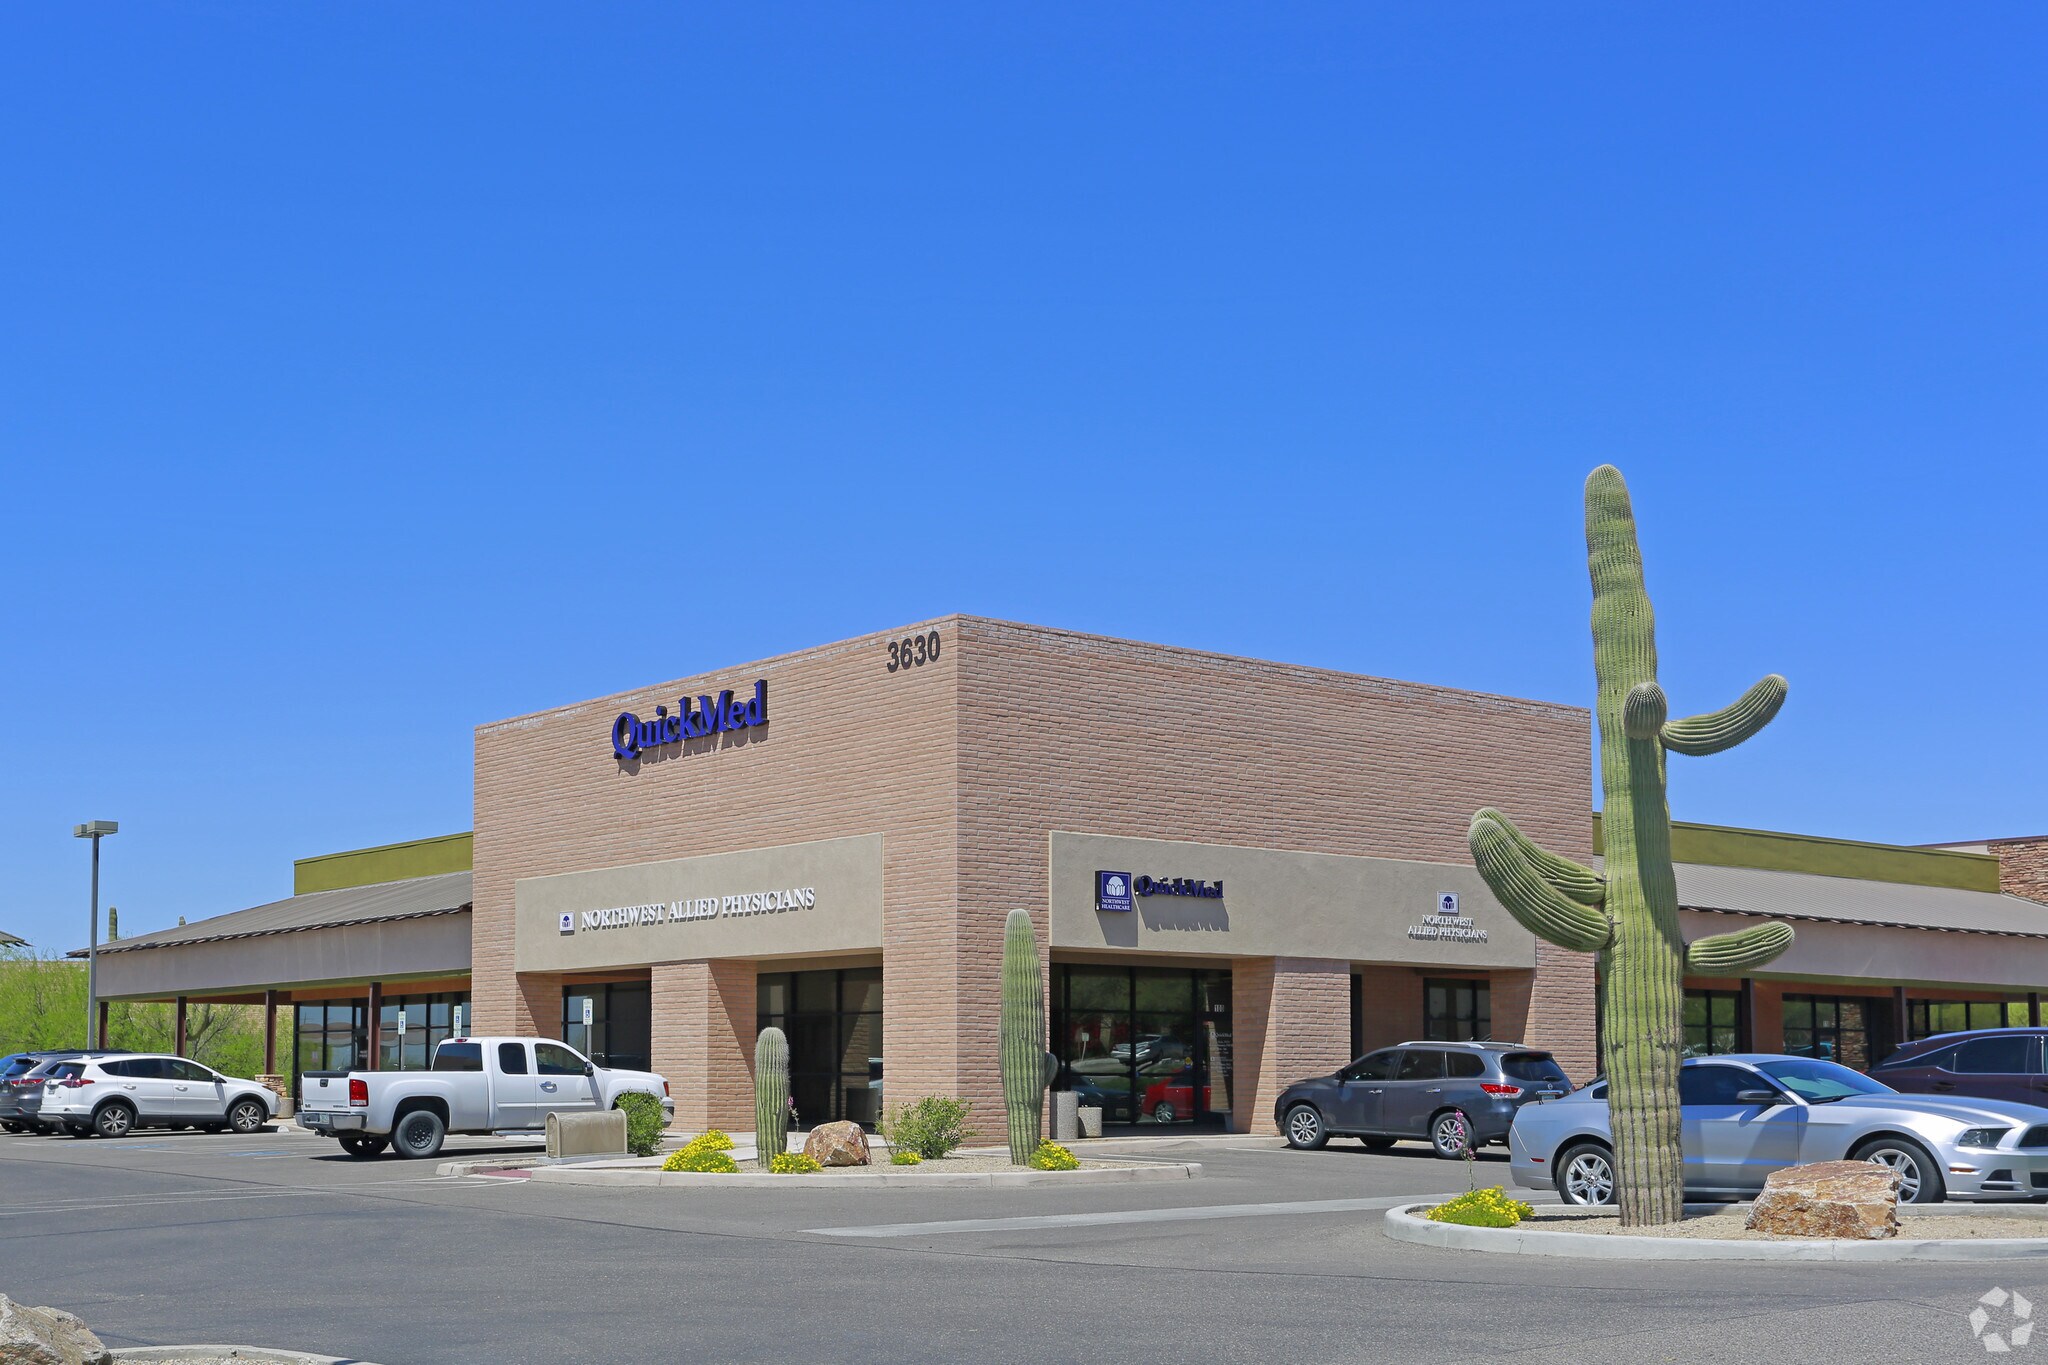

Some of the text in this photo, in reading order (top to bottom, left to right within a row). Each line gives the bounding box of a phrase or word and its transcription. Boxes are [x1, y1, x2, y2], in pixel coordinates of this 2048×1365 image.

[886, 631, 940, 673] 3630
[611, 679, 769, 760] QuickMed
[1133, 875, 1225, 899] QuickMed
[581, 887, 816, 930] NORTHWEST ALLIED PHYSICIANS
[1101, 903, 1131, 911] HEALTHCARE
[1408, 925, 1488, 939] ALLIED PHYSICIANS
[1422, 915, 1473, 926] NORTHWEST
